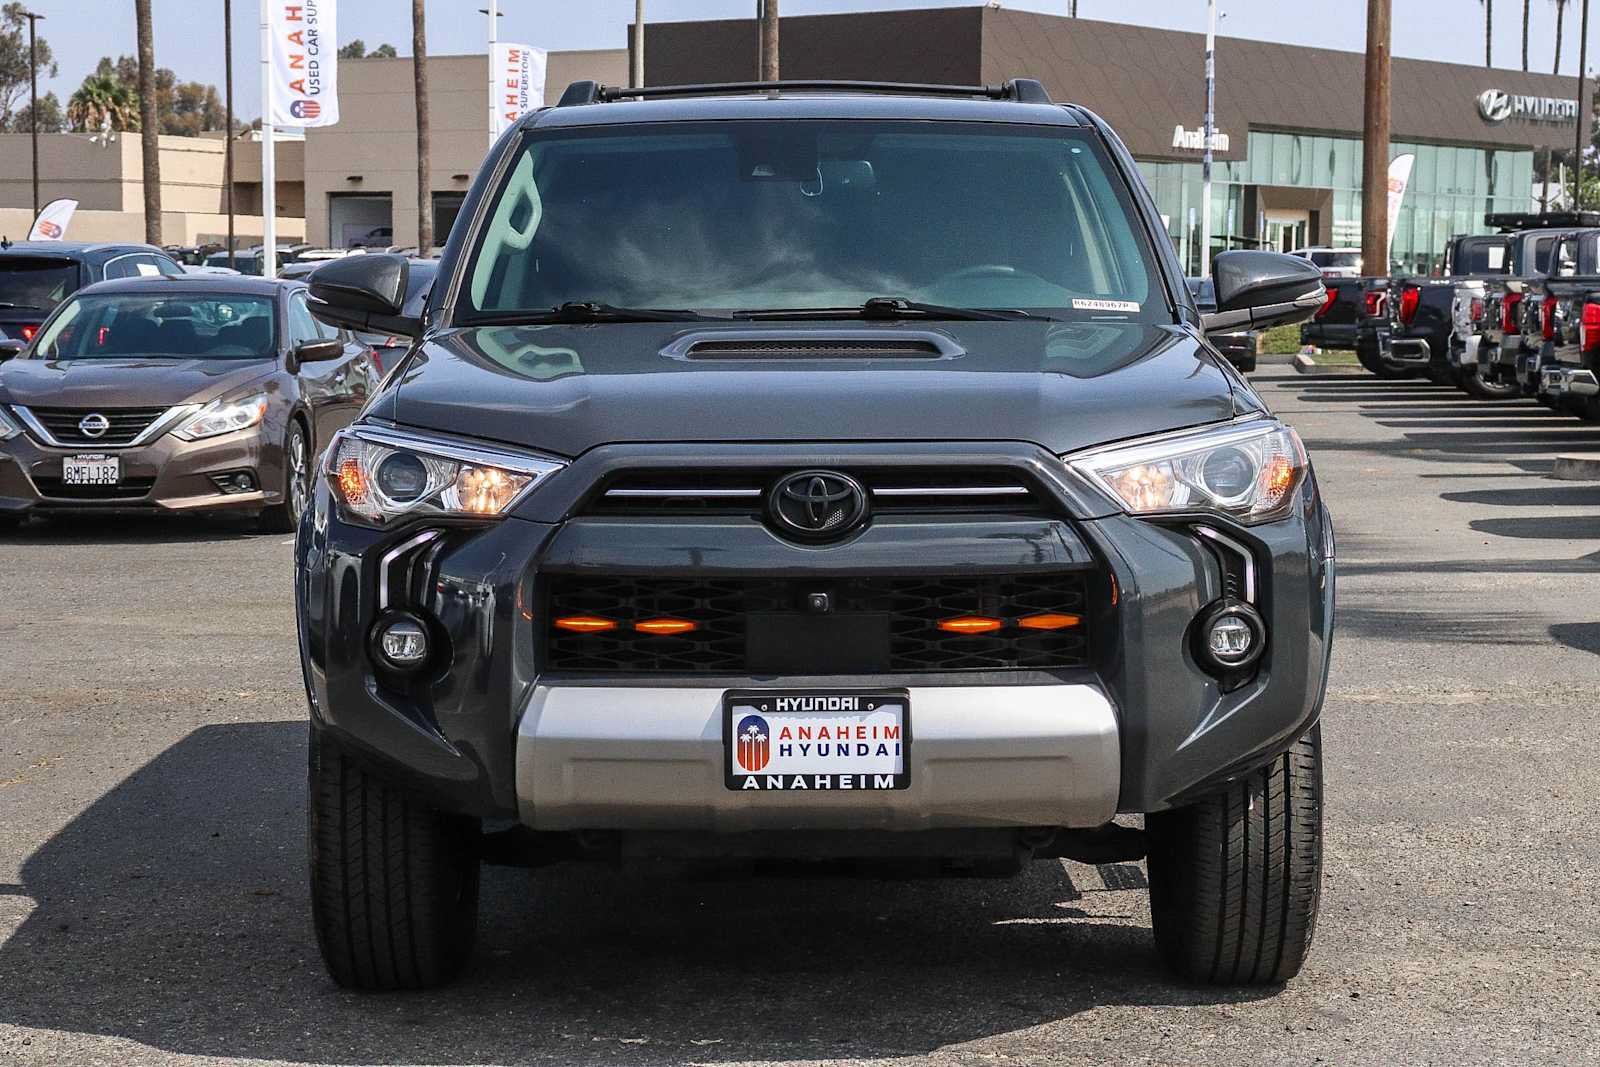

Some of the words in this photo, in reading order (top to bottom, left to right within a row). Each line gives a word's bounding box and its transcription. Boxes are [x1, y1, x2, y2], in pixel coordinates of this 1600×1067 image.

[307, 29, 319, 56] CAR
[309, 60, 321, 96] USED
[520, 50, 530, 110] SUPERSTORE
[1172, 125, 1230, 152] Anahim
[776, 698, 859, 711] HYUNDAI
[779, 726, 900, 740] ANAHEIM
[779, 743, 900, 757] HYUNDAI
[742, 775, 895, 790] ANAHEIM
